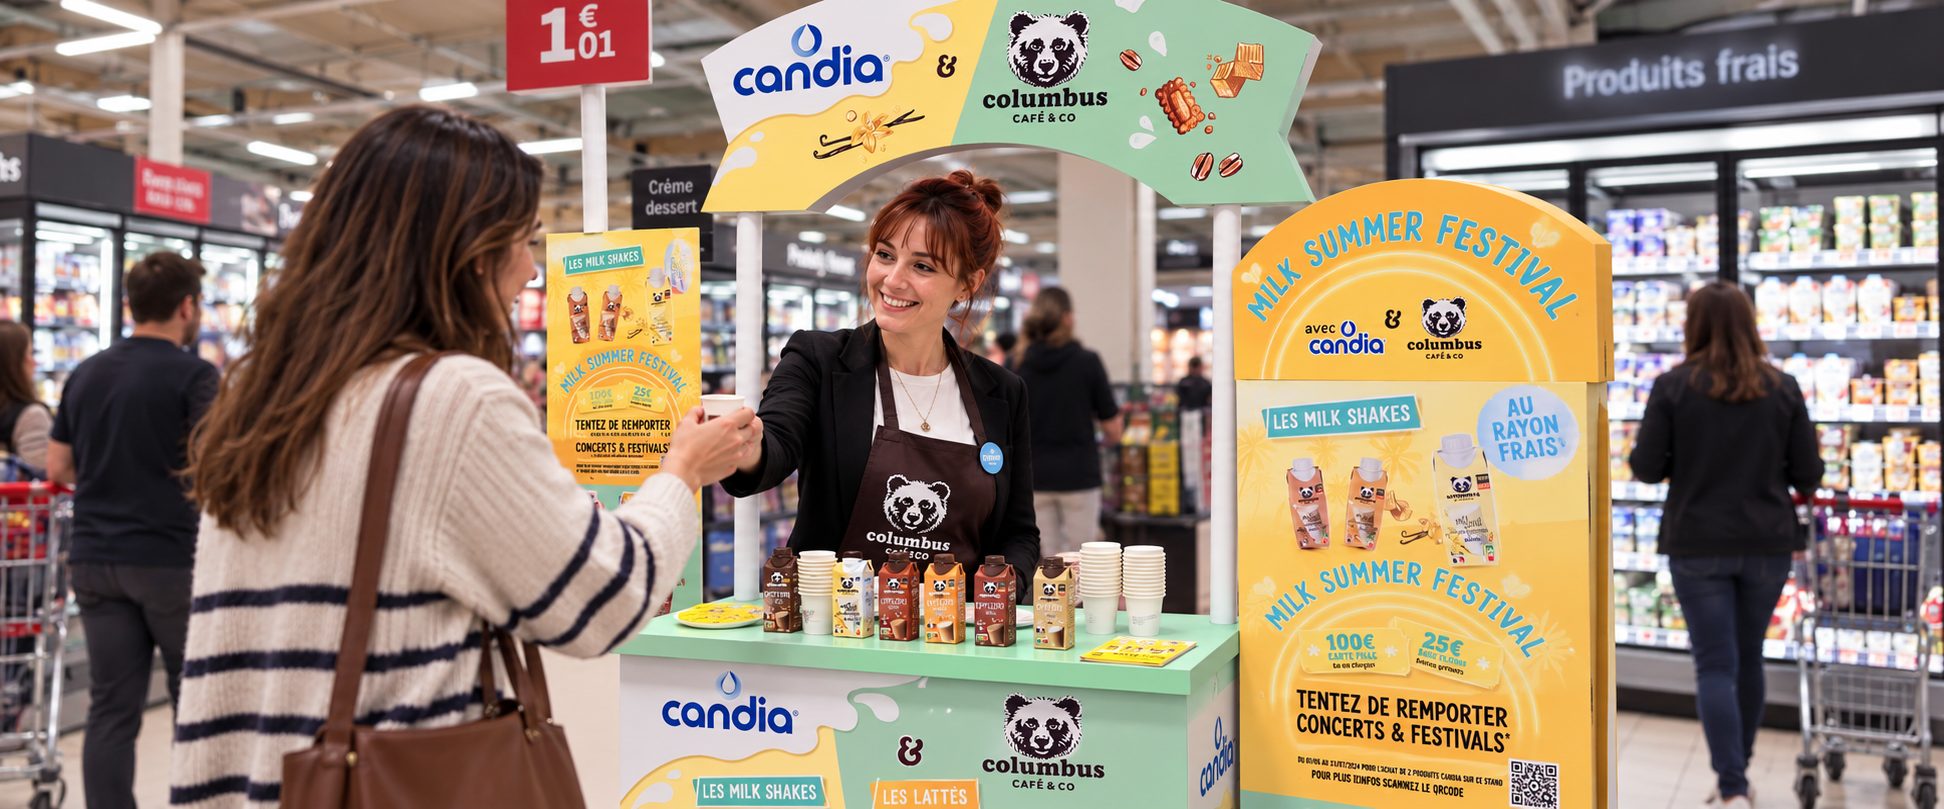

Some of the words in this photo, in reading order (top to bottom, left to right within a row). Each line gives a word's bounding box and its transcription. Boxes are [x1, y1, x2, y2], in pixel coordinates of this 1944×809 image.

[935, 54, 958, 79] &
[1563, 54, 1706, 99] Produits
[1716, 43, 1800, 84] frais
[983, 88, 1108, 109] columbus
[1012, 111, 1045, 124] CAFÉ
[1047, 112, 1057, 123] &
[1058, 113, 1077, 123] CO
[645, 199, 698, 216] dessert
[568, 258, 583, 270] LES
[585, 255, 605, 268] MILK
[607, 251, 640, 265] SHAKES
[1247, 256, 1302, 323] MILK
[1304, 211, 1423, 268] SUMMER
[1436, 213, 1578, 321] FESTIVAL
[1305, 324, 1336, 334] avec
[1384, 309, 1402, 329] &
[1309, 333, 1385, 355] candia
[1407, 338, 1482, 350] columbus
[1425, 351, 1445, 360] CAFÉ
[560, 363, 587, 393] MILK
[587, 349, 634, 370] SUMMER
[638, 351, 687, 393] FESTIVAL
[1273, 413, 1298, 430] LES
[1304, 409, 1342, 428] MILK
[1348, 405, 1411, 426] SHAKES
[1507, 395, 1533, 418] AU
[575, 419, 606, 430] TENTEZ
[608, 419, 619, 430] DE
[621, 419, 671, 430] REMPORTER
[1492, 414, 1559, 442] RAYON
[575, 442, 617, 453] CONCERTS
[618, 442, 625, 452] &
[866, 531, 950, 552] columbus
[1264, 580, 1317, 631] MILK
[1319, 560, 1422, 595] SUMMER
[1432, 568, 1548, 659] FESTIVAL
[1325, 633, 1376, 651] 100€
[1421, 631, 1464, 657] 25€
[1296, 689, 1361, 714] TENTEZ
[1368, 695, 1390, 717] DE
[1397, 696, 1509, 729] REMPORTER
[1296, 713, 1385, 740] CONCERTS
[1391, 722, 1405, 743] &
[896, 734, 924, 767] &
[982, 757, 1105, 779] columbus
[1200, 735, 1233, 797] candia
[703, 783, 725, 799] LES
[729, 783, 761, 800] MILK
[765, 784, 817, 800] SHAKES
[1012, 778, 1044, 790] CAFÉ
[1047, 781, 1055, 790] &
[1058, 782, 1075, 791] CO
[1311, 769, 1331, 780] POUR
[1333, 772, 1351, 783] PLUS
[1422, 782, 1431, 793] LE
[1433, 784, 1464, 797] QRCODE
[883, 788, 907, 805] LES
